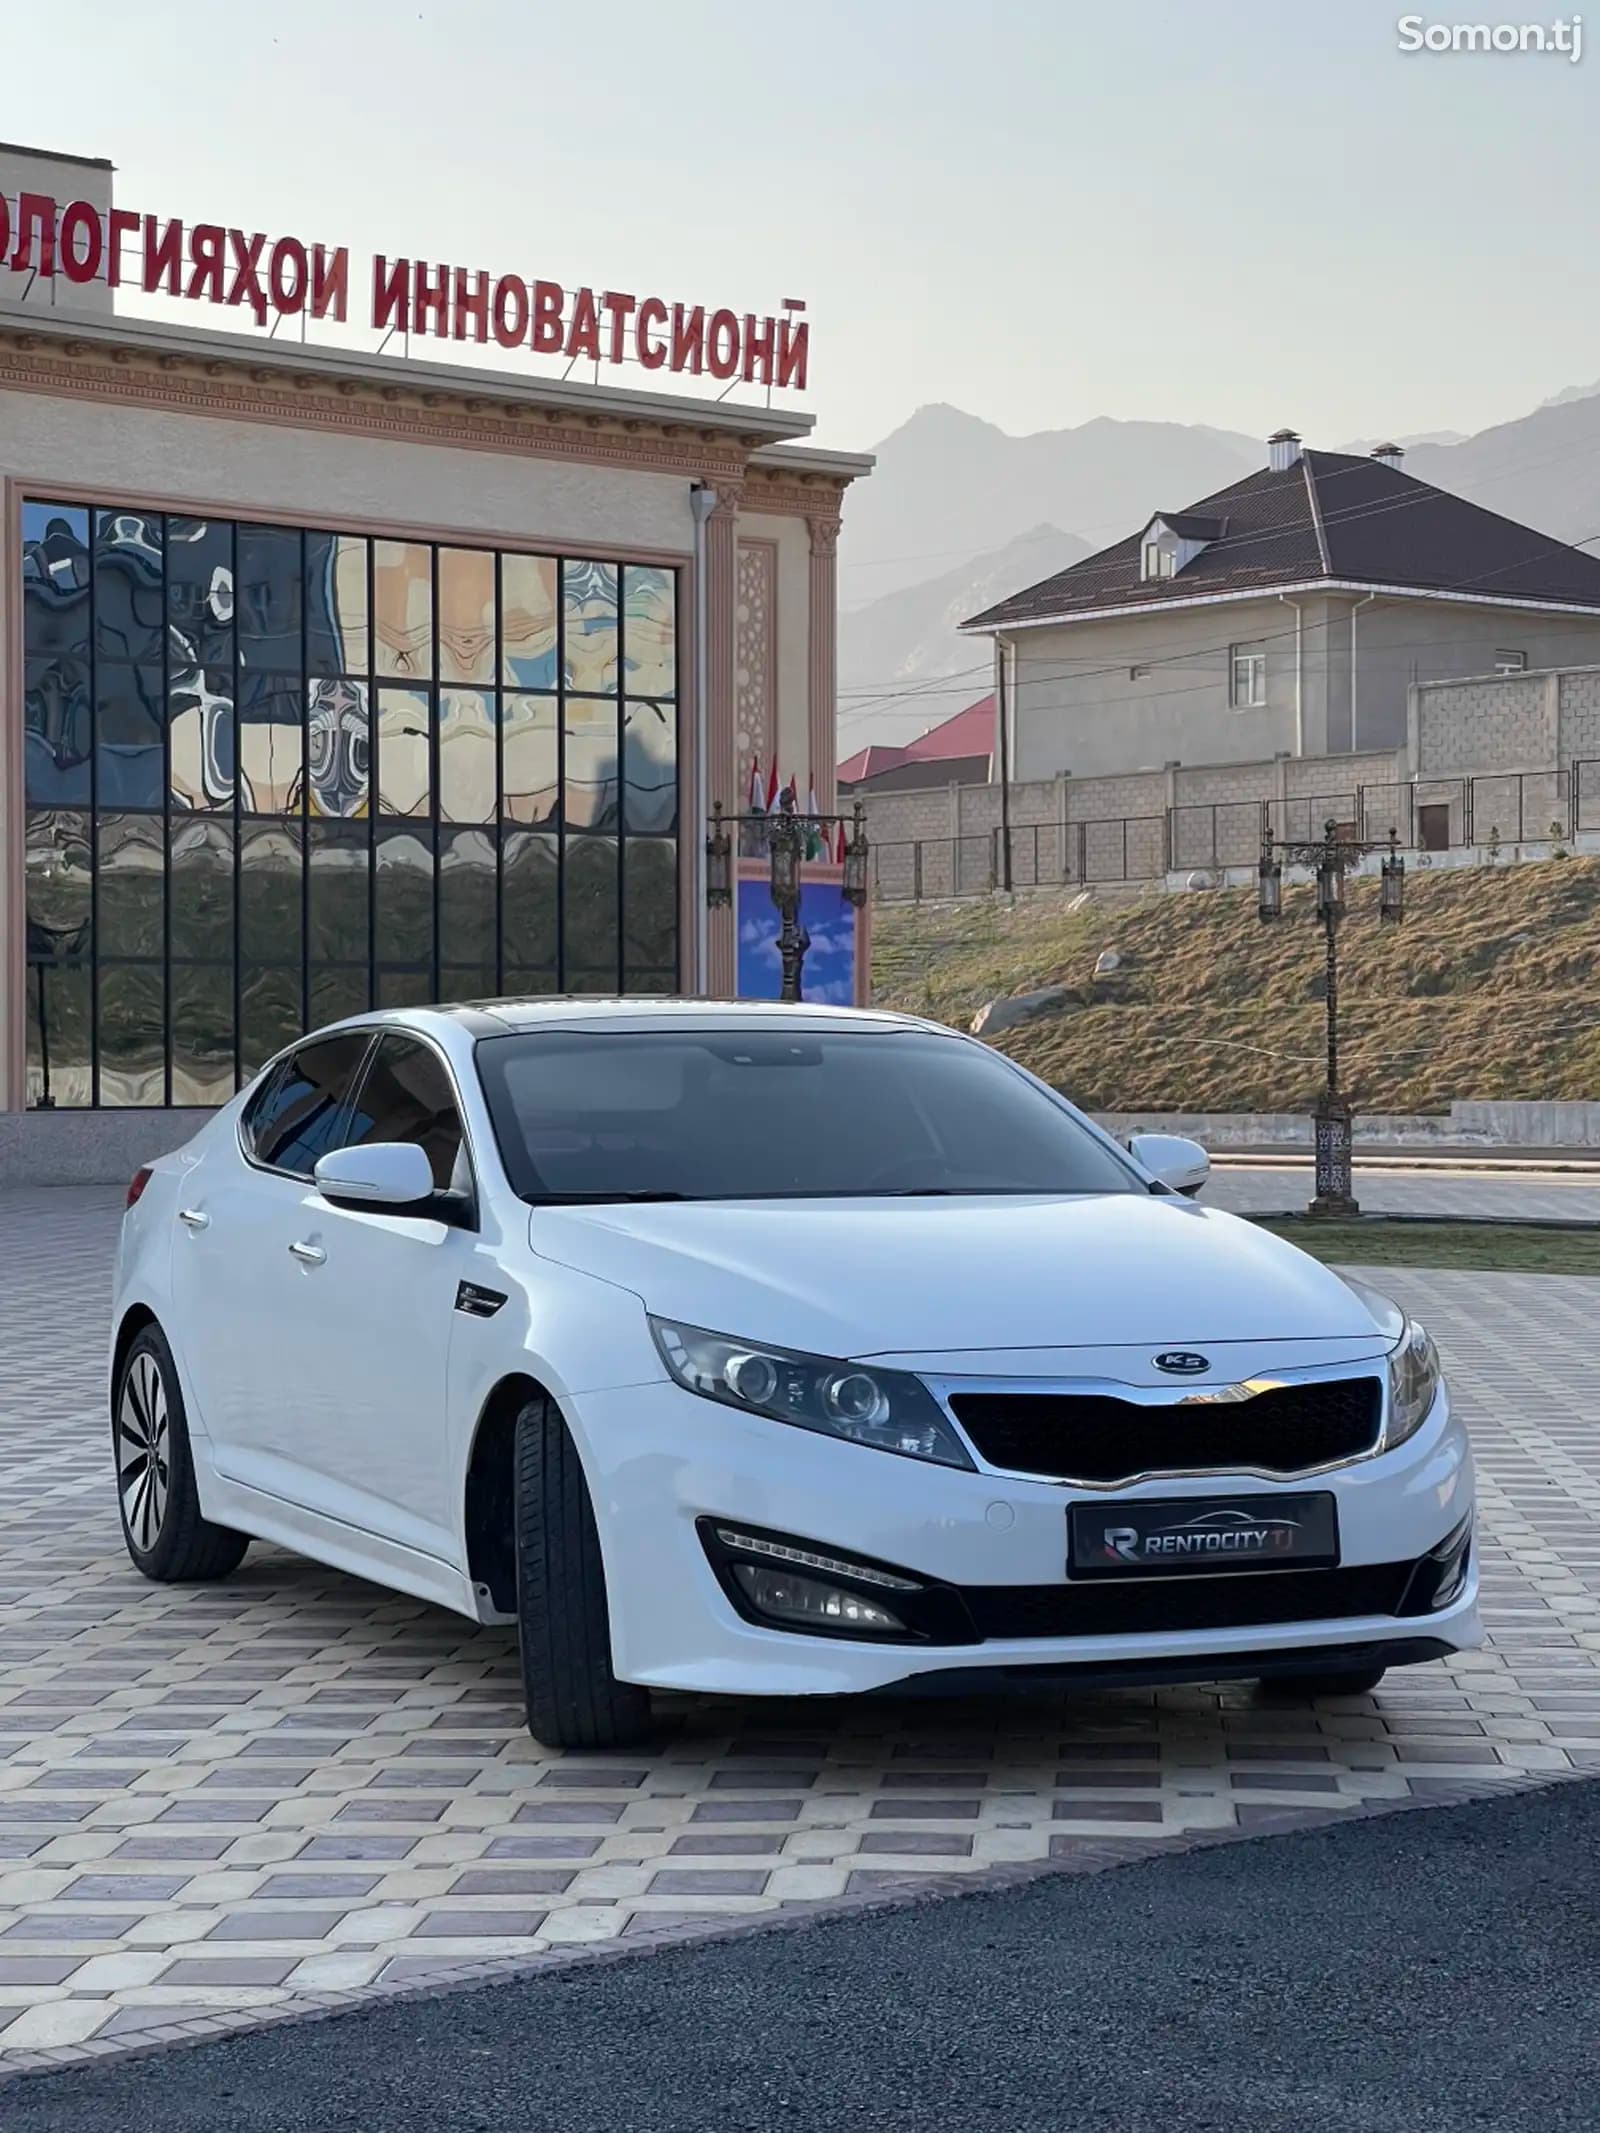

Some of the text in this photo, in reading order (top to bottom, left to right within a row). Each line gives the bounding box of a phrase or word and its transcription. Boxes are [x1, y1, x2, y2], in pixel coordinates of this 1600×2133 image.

[0, 190, 809, 391] ЛОГИЯҲОИ ИННОВАТСИОНӢ
[1145, 1530, 1268, 1554] RENTOCITY
